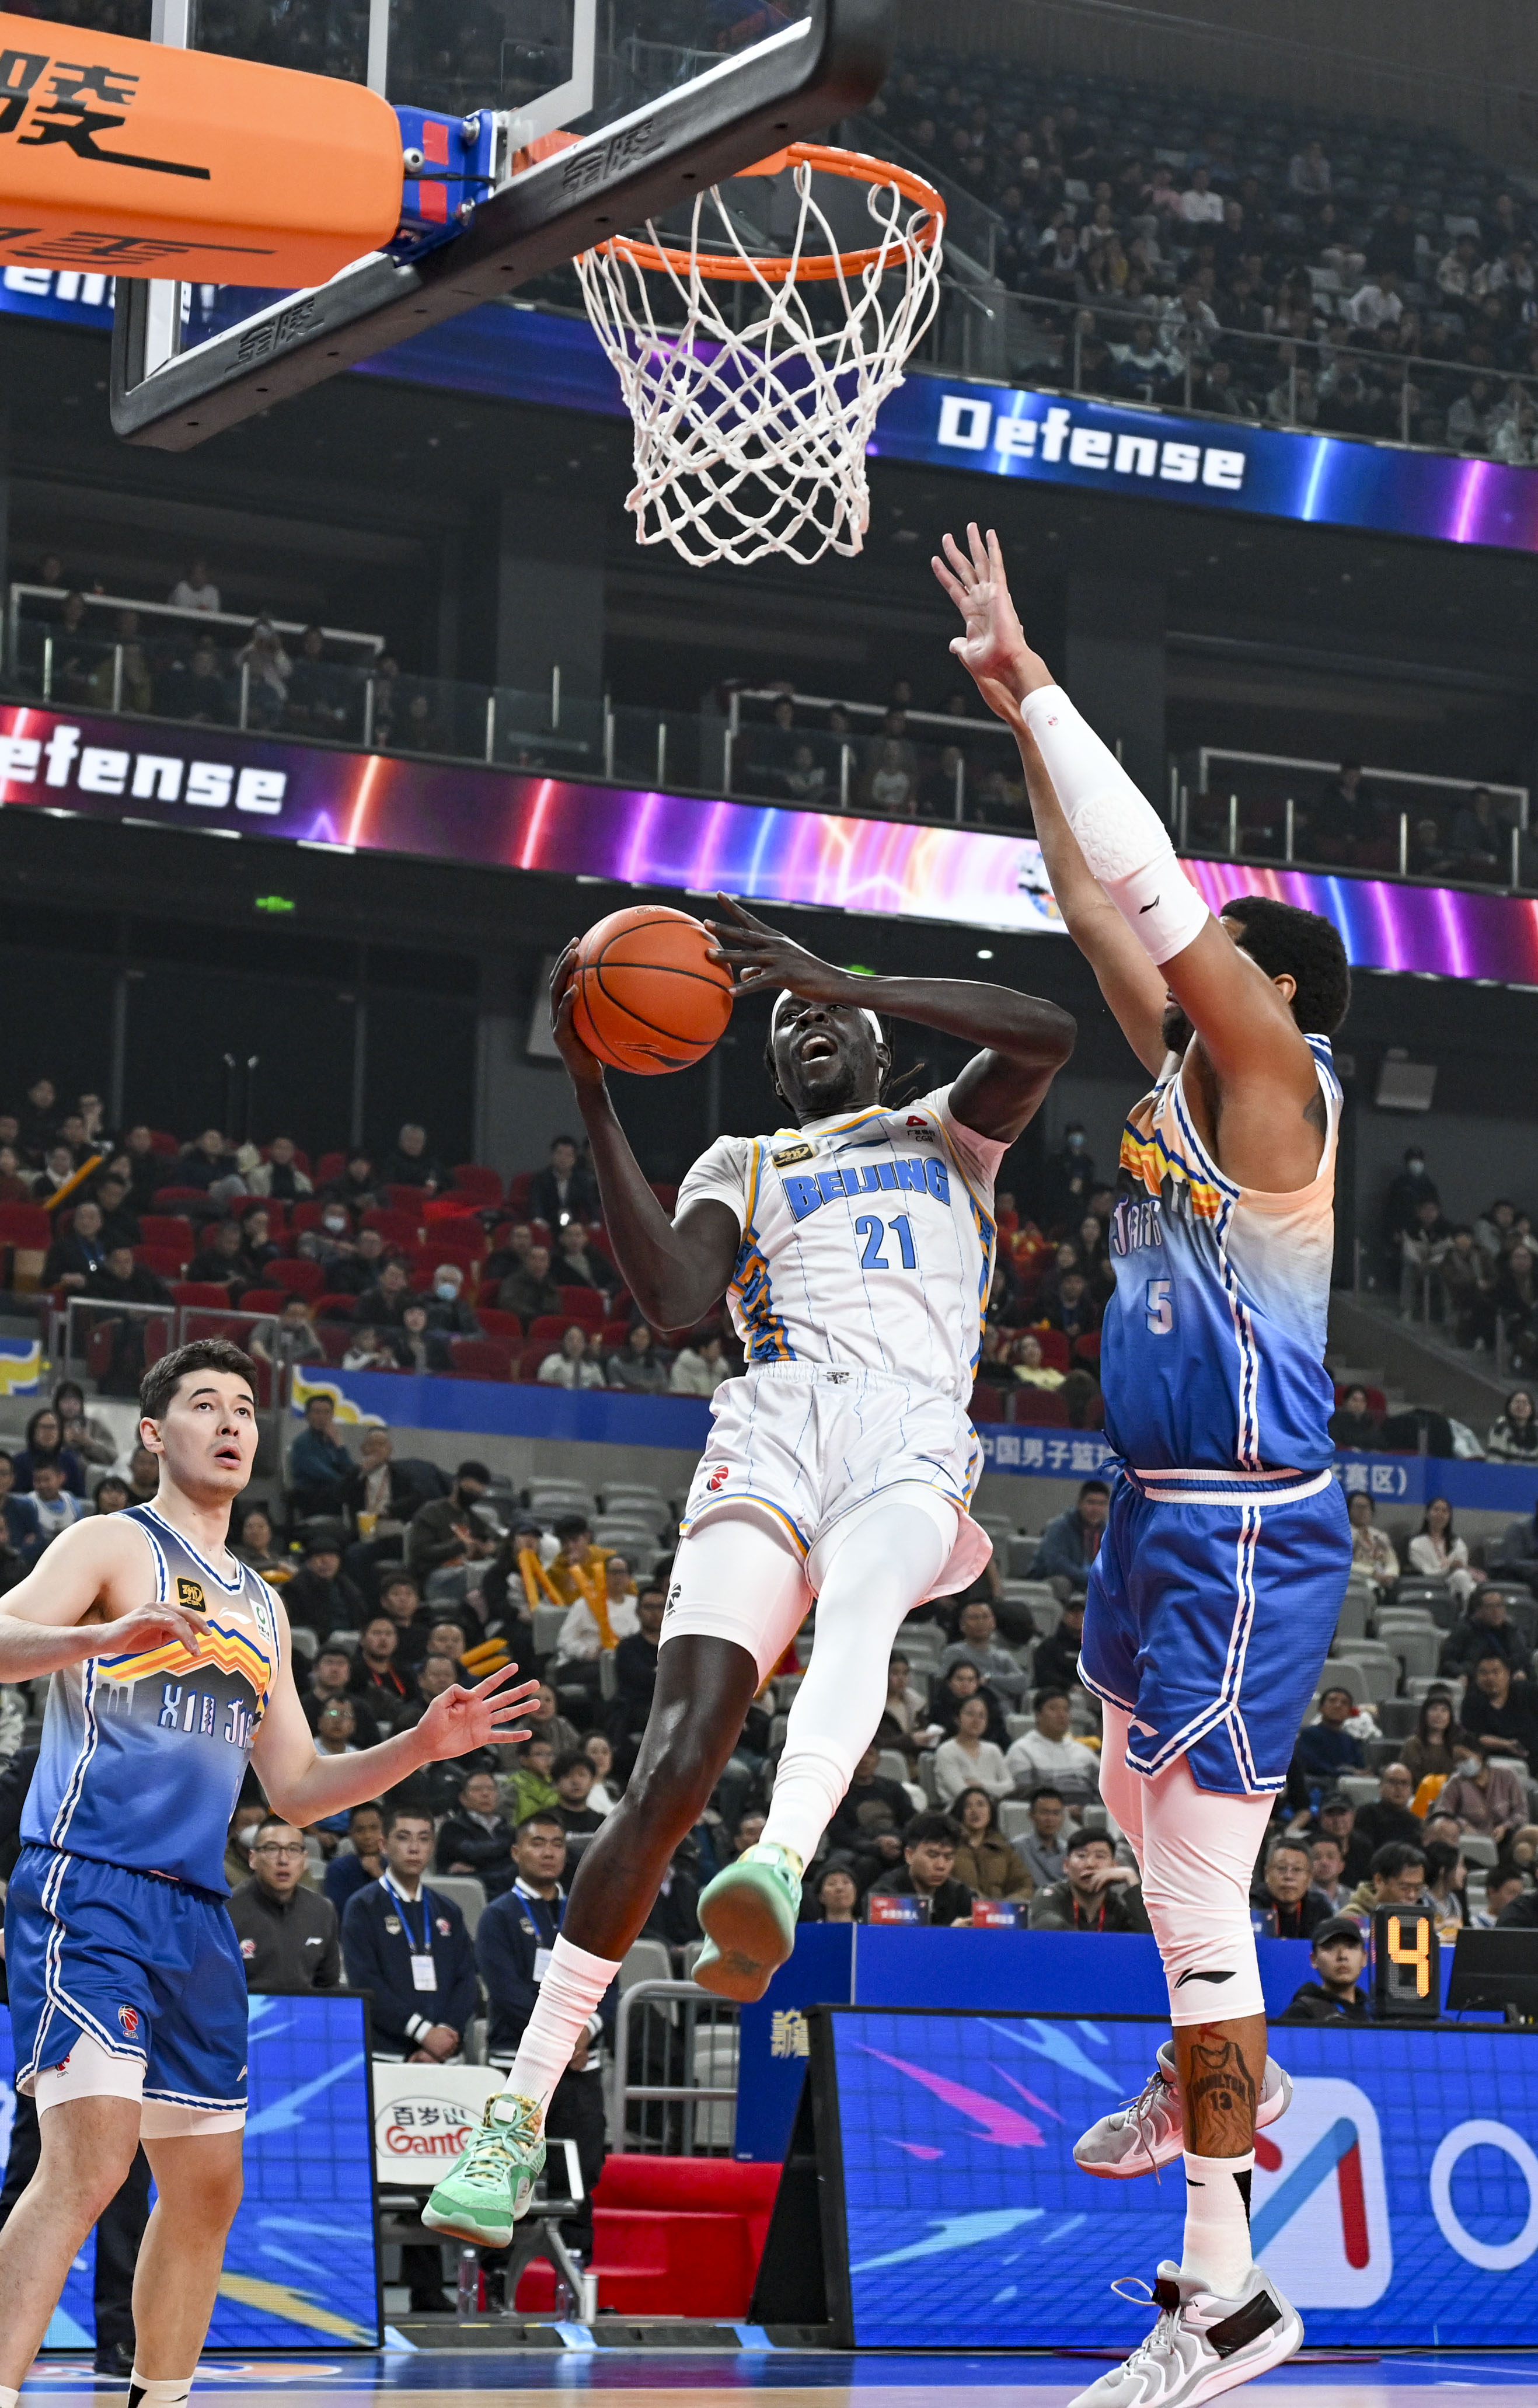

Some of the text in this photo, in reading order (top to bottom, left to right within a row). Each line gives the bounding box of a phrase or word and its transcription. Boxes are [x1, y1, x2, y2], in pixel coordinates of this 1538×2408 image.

[225, 297, 325, 374] 金陵
[937, 395, 1245, 490] Defense
[783, 1158, 950, 1221] BEIJING
[855, 1215, 916, 1269] 21
[1146, 1278, 1173, 1334] 5
[1387, 1916, 1429, 1997] 4
[123, 2030, 139, 2040] CBA
[392, 2106, 466, 2126] 百岁山
[1210, 2091, 1233, 2111] 13
